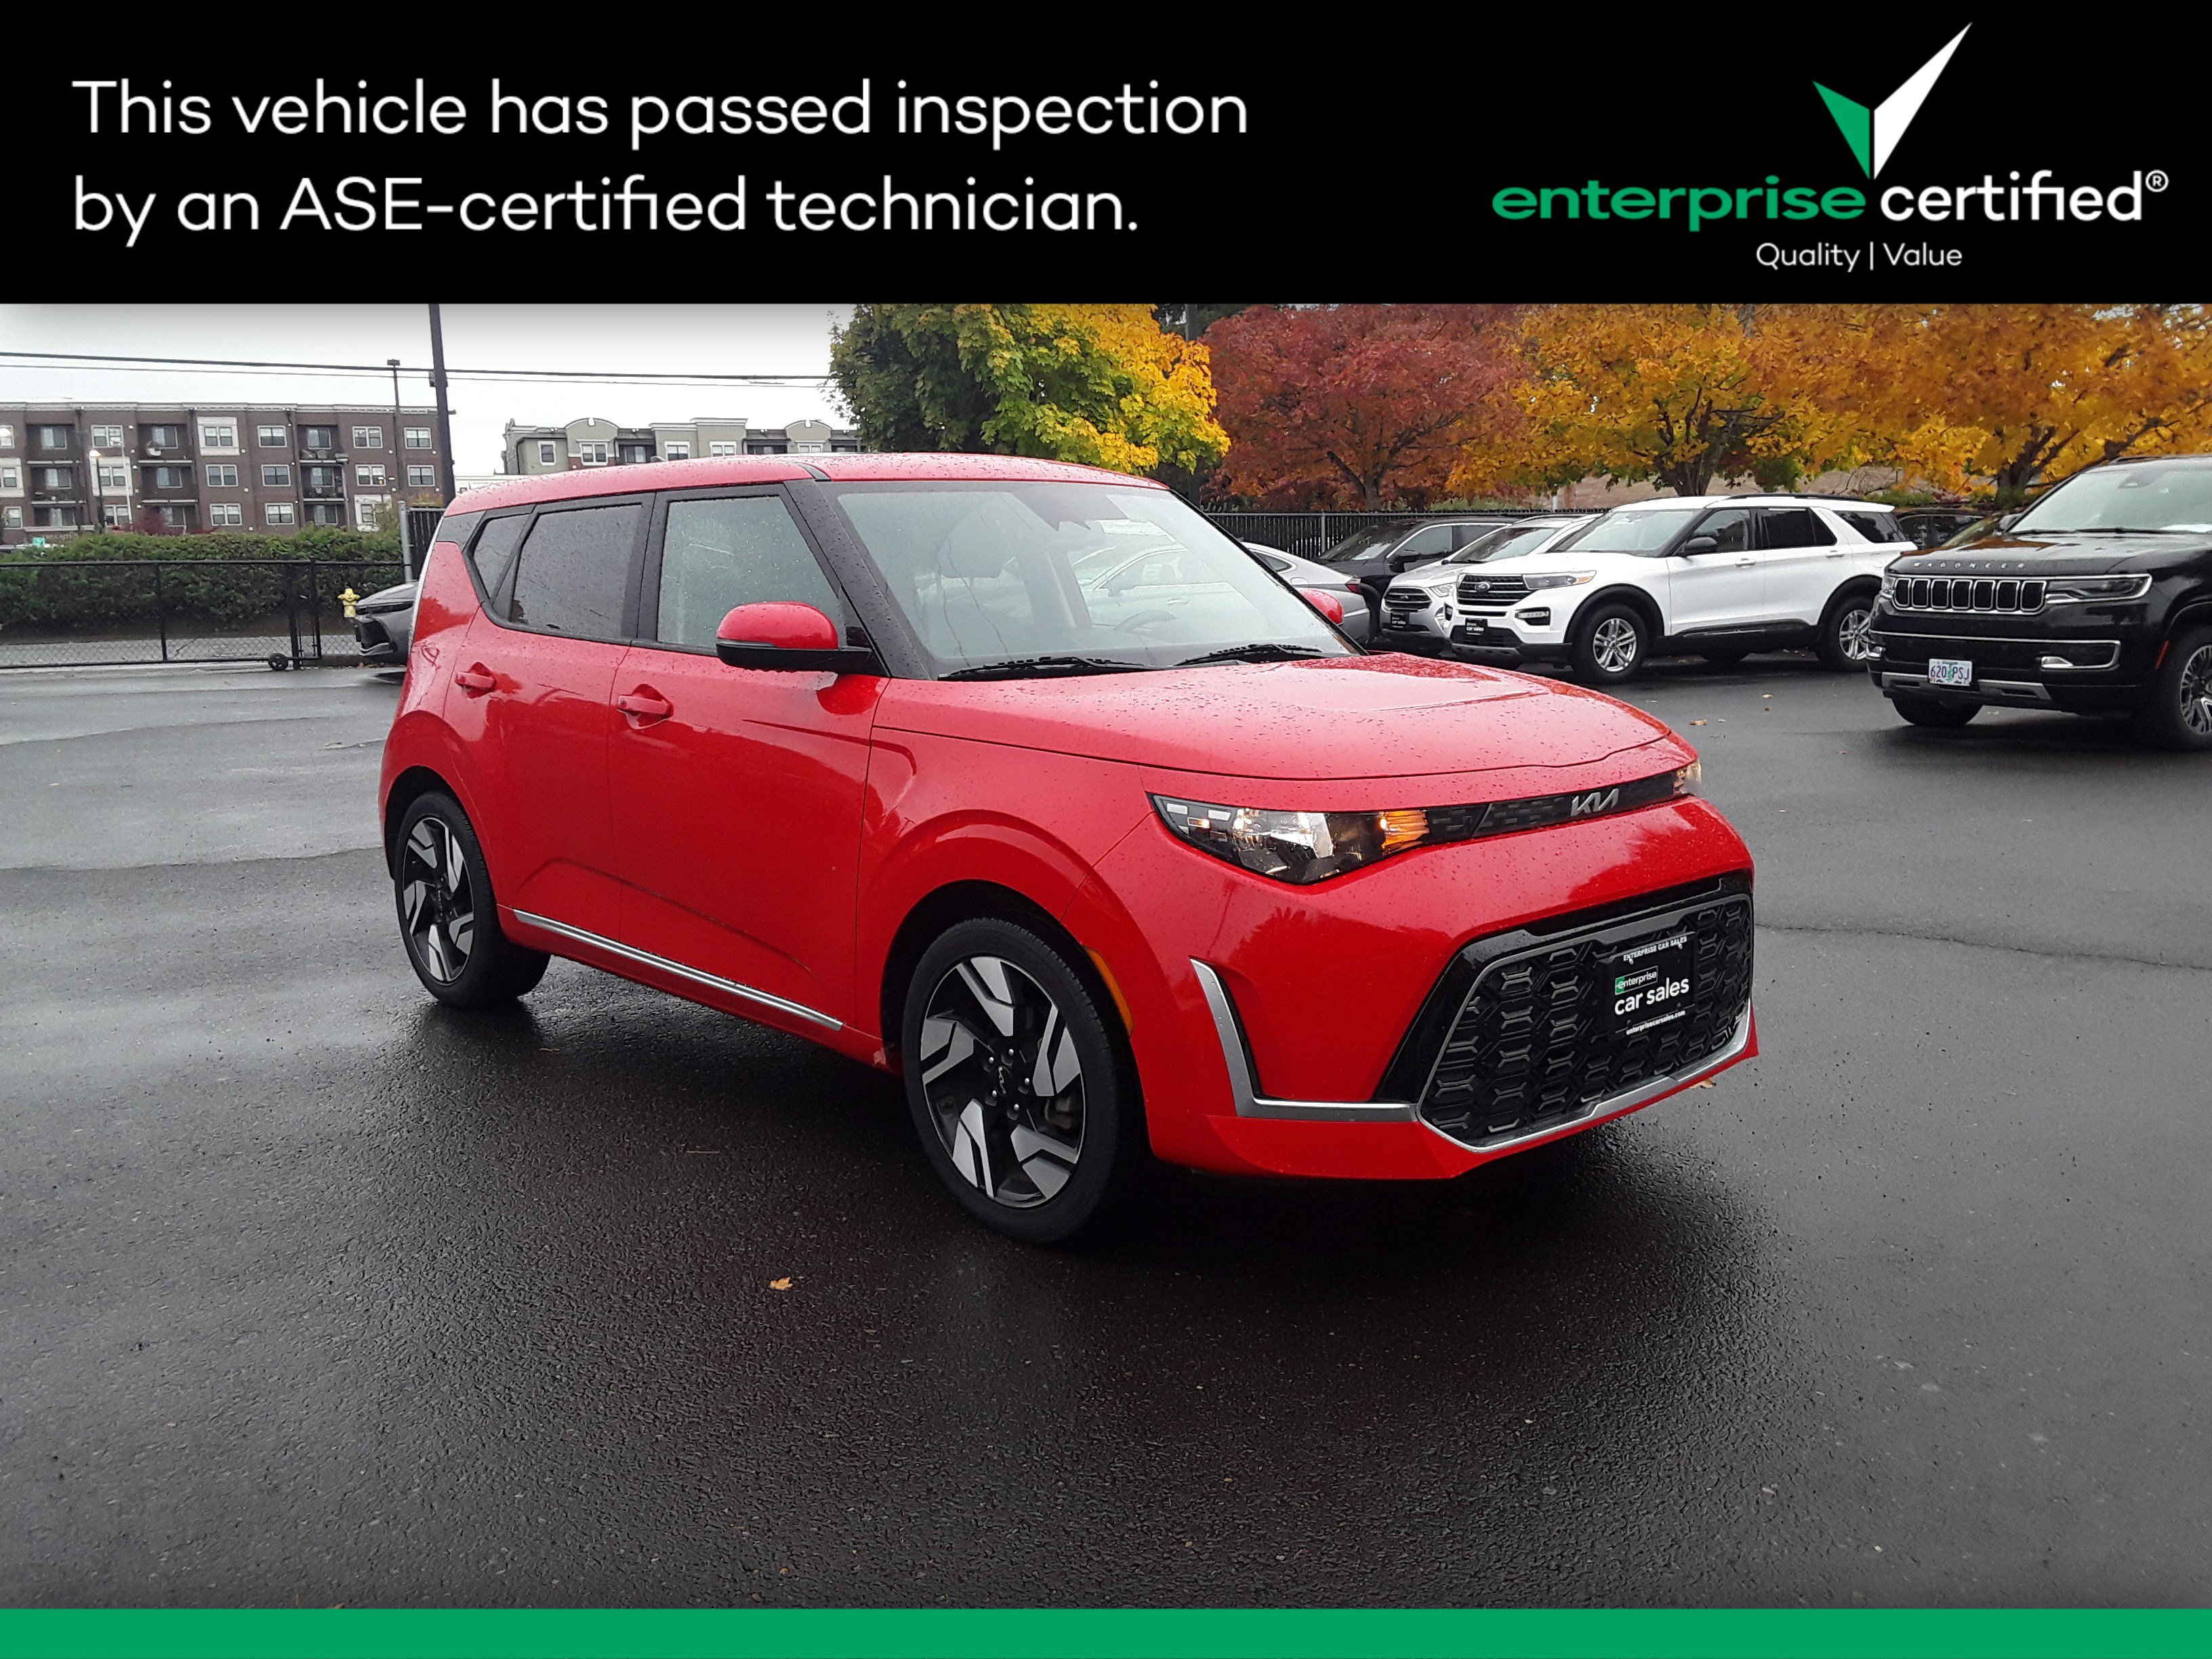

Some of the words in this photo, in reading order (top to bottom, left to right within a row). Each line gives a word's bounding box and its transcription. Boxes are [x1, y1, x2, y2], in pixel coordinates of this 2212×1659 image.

[1930, 665, 1947, 678] 620
[1658, 941, 1669, 951] CAR
[1616, 971, 1657, 989] enterprise
[1614, 993, 1643, 1015] car
[1646, 977, 1689, 1005] sales
